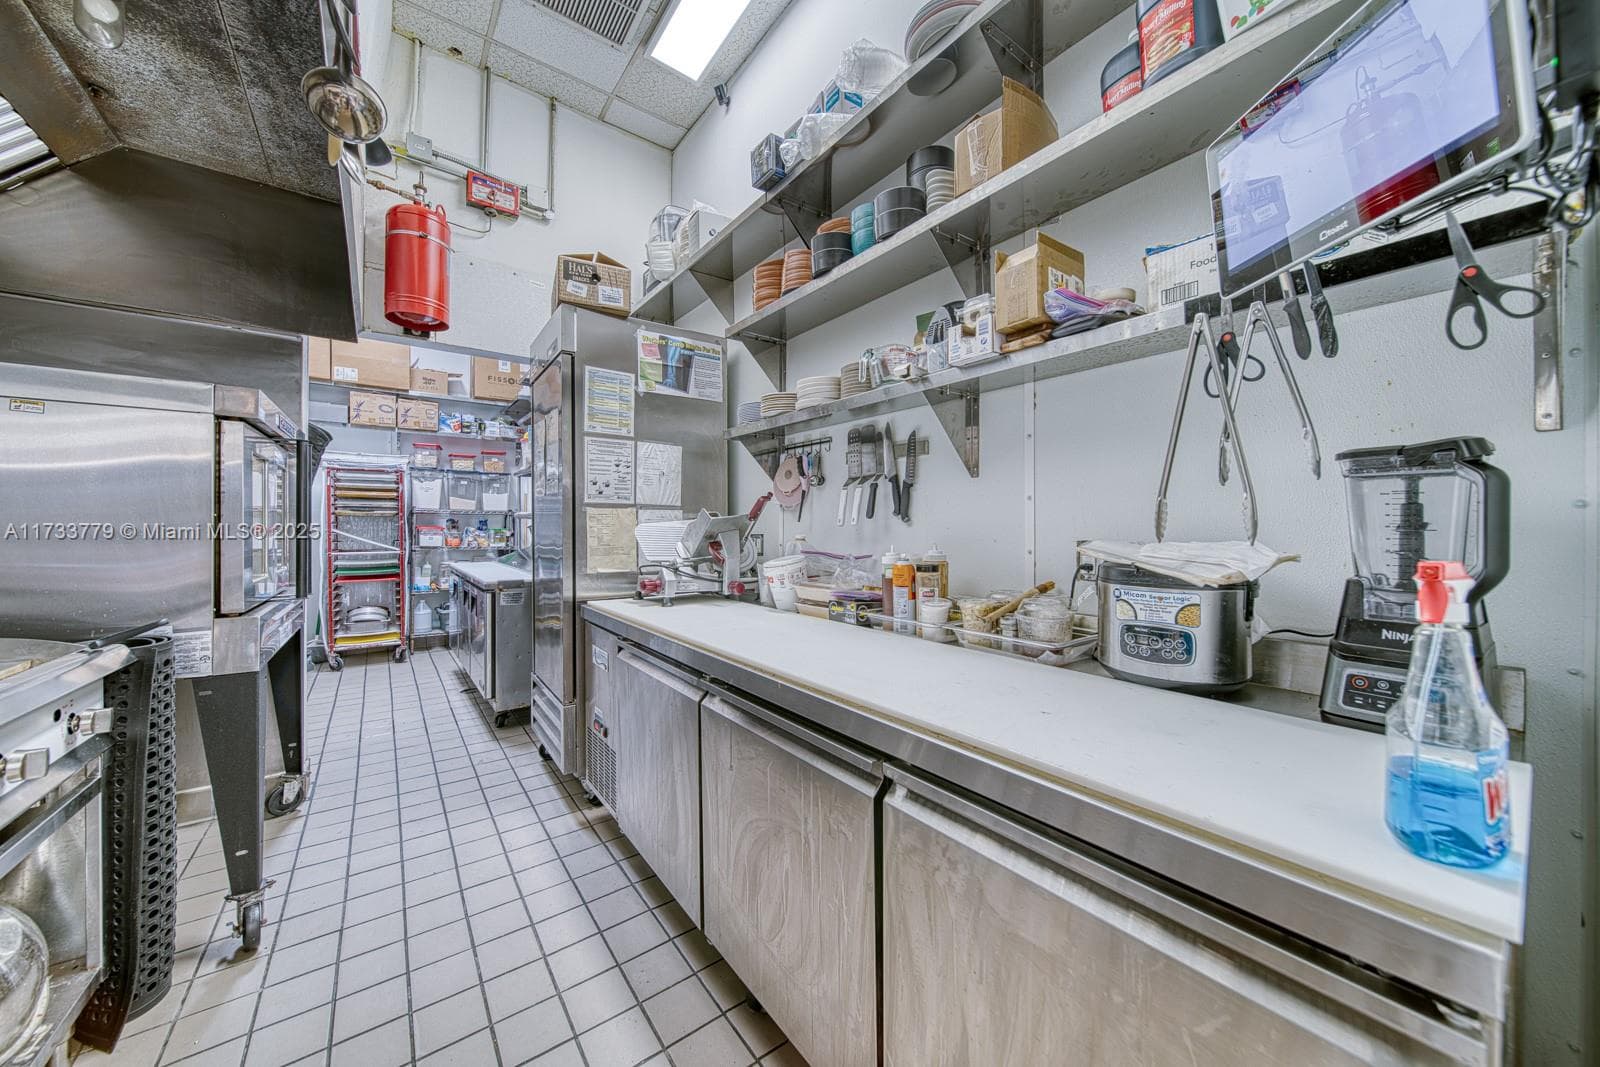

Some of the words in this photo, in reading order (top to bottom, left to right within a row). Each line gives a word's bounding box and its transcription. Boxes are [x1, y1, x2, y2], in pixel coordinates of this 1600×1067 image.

[568, 262, 593, 275] HAL'S
[1123, 591, 1147, 599] Micom
[1173, 595, 1190, 603] Logic
